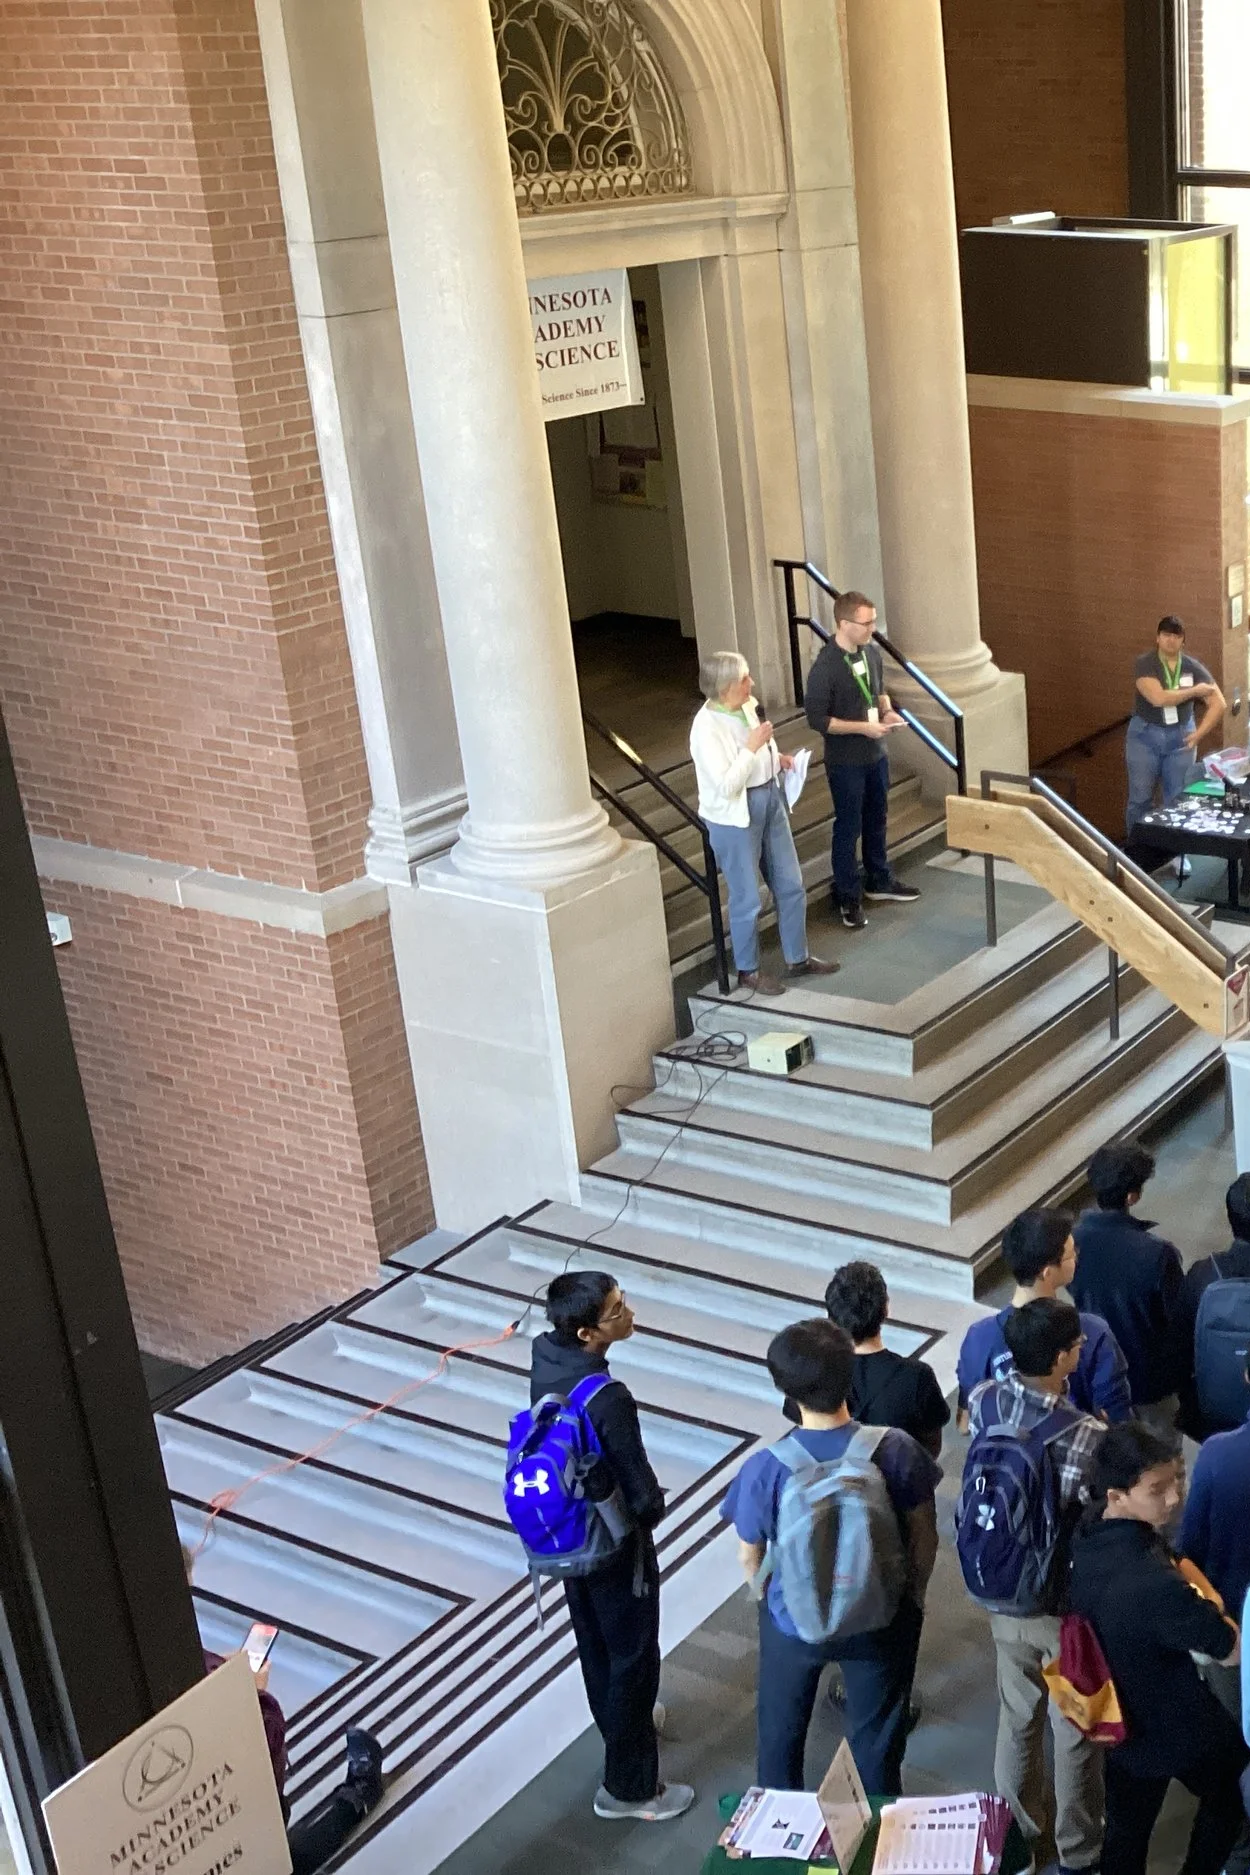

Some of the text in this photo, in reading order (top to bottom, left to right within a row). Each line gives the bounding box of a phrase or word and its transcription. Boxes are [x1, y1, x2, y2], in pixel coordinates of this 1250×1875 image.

[529, 288, 612, 315] NESOTA
[535, 316, 605, 342] ADEMY
[536, 341, 619, 370] SCIENCE
[542, 391, 574, 405] Science
[575, 387, 599, 398] Since
[110, 1761, 233, 1869] MINNESOTA
[130, 1785, 223, 1875] ACADEMY
[155, 1794, 242, 1875] SCIENCE
